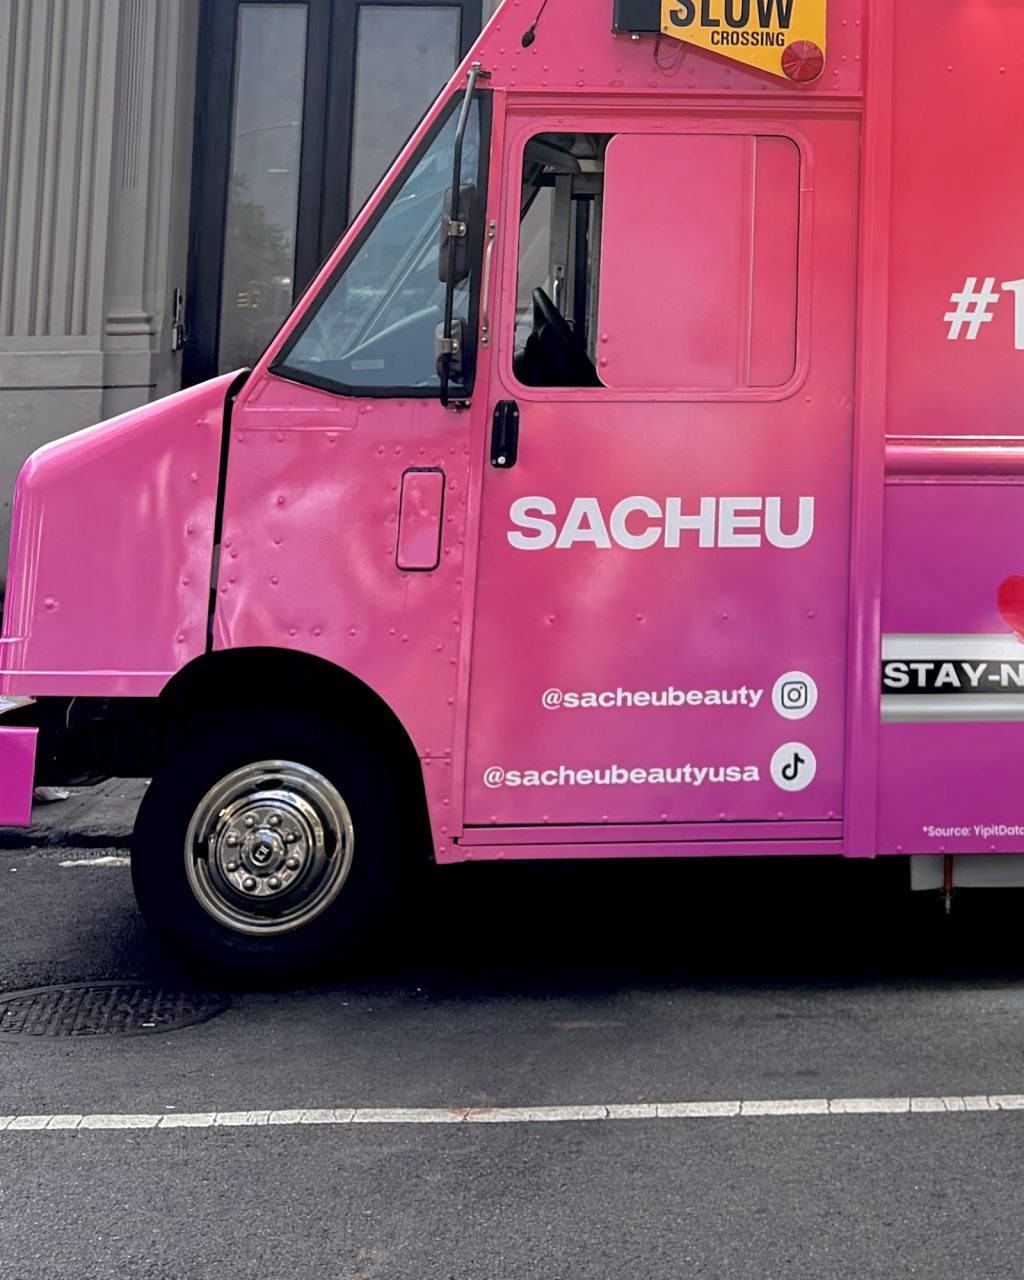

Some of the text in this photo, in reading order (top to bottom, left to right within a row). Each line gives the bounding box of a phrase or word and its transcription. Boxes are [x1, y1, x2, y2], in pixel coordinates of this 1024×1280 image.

[711, 30, 785, 47] CROSSING
[506, 495, 815, 550] SACHEU
[541, 686, 764, 710] @sacheubeauty
[483, 763, 760, 789] @sacheubeautyusa
